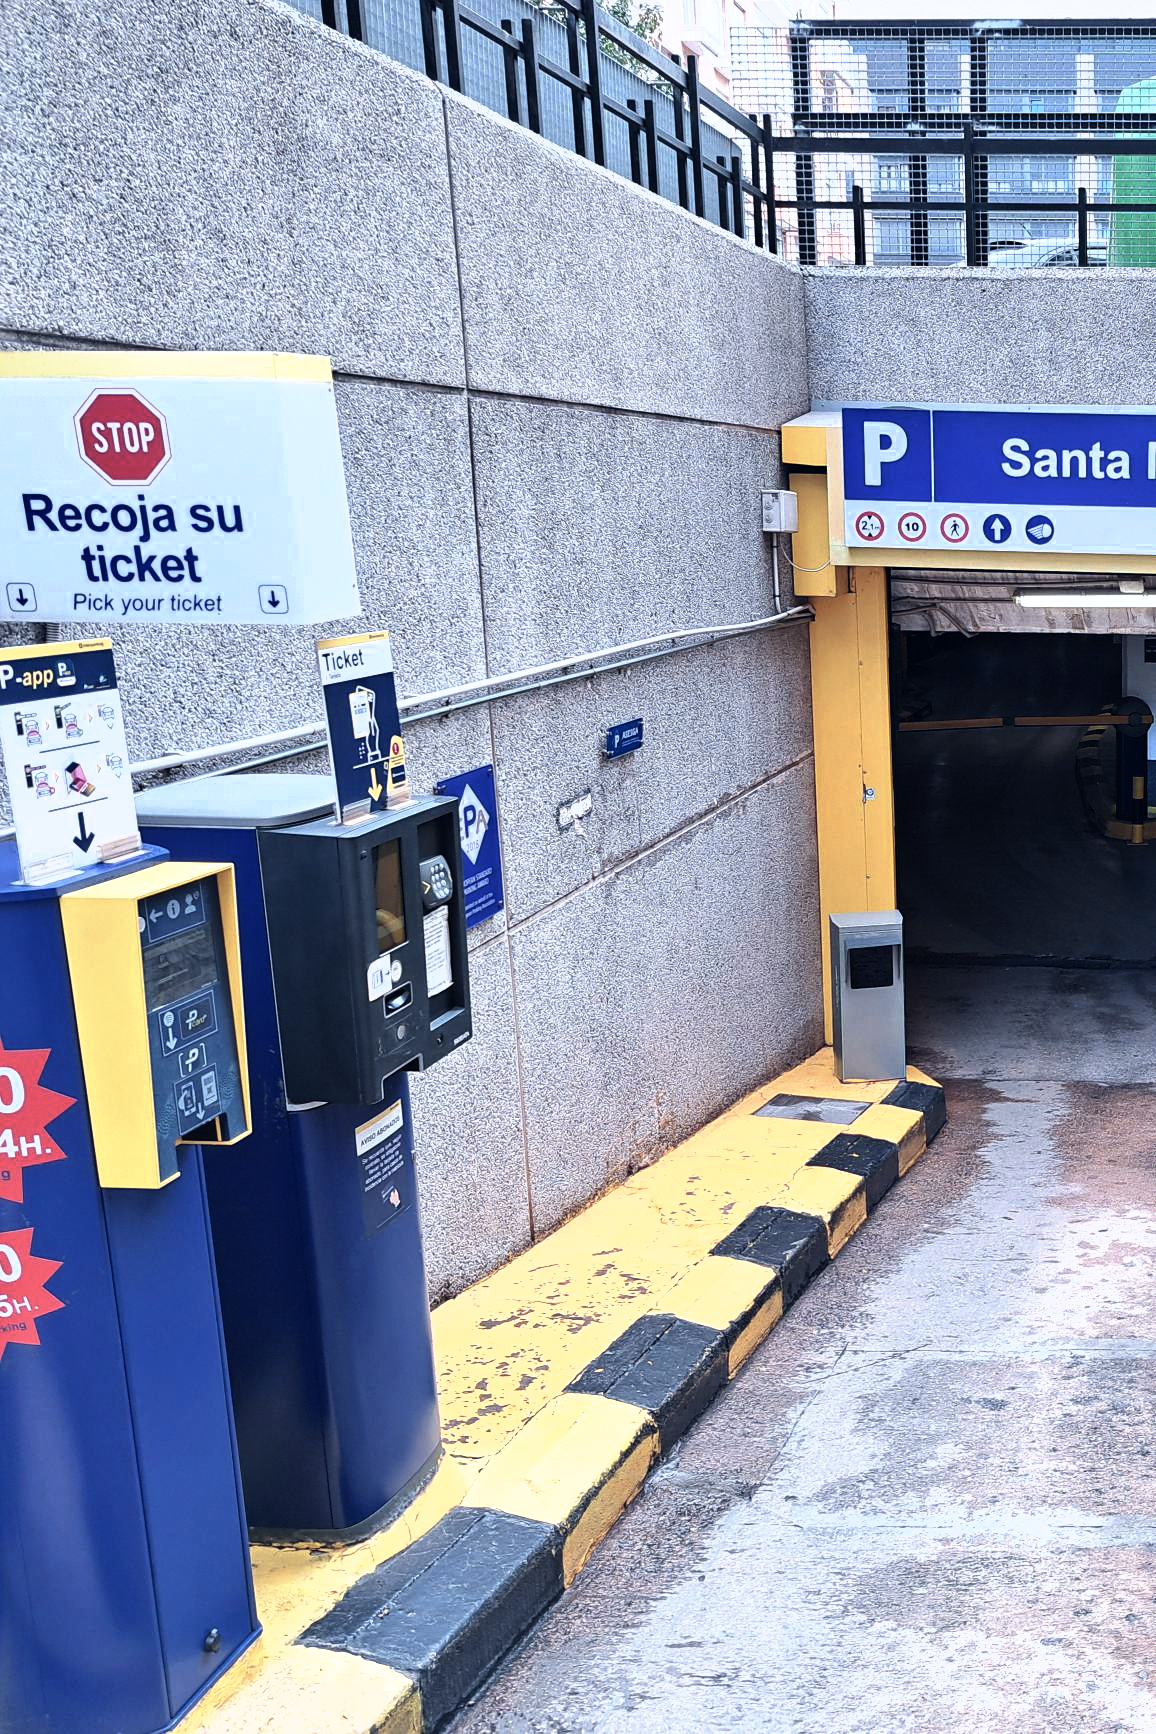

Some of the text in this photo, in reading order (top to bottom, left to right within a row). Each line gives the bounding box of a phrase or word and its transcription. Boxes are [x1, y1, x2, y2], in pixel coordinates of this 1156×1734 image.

[92, 421, 154, 453] STOP
[863, 421, 908, 487] P
[1001, 438, 1131, 480] Santa
[22, 493, 244, 542] Recoja su
[905, 522, 919, 532] 10
[81, 545, 203, 583] ticket
[73, 593, 223, 616] Pick your ticket
[322, 649, 365, 672] Ticket
[460, 804, 489, 840] PA
[0, 1322, 27, 1334] king
